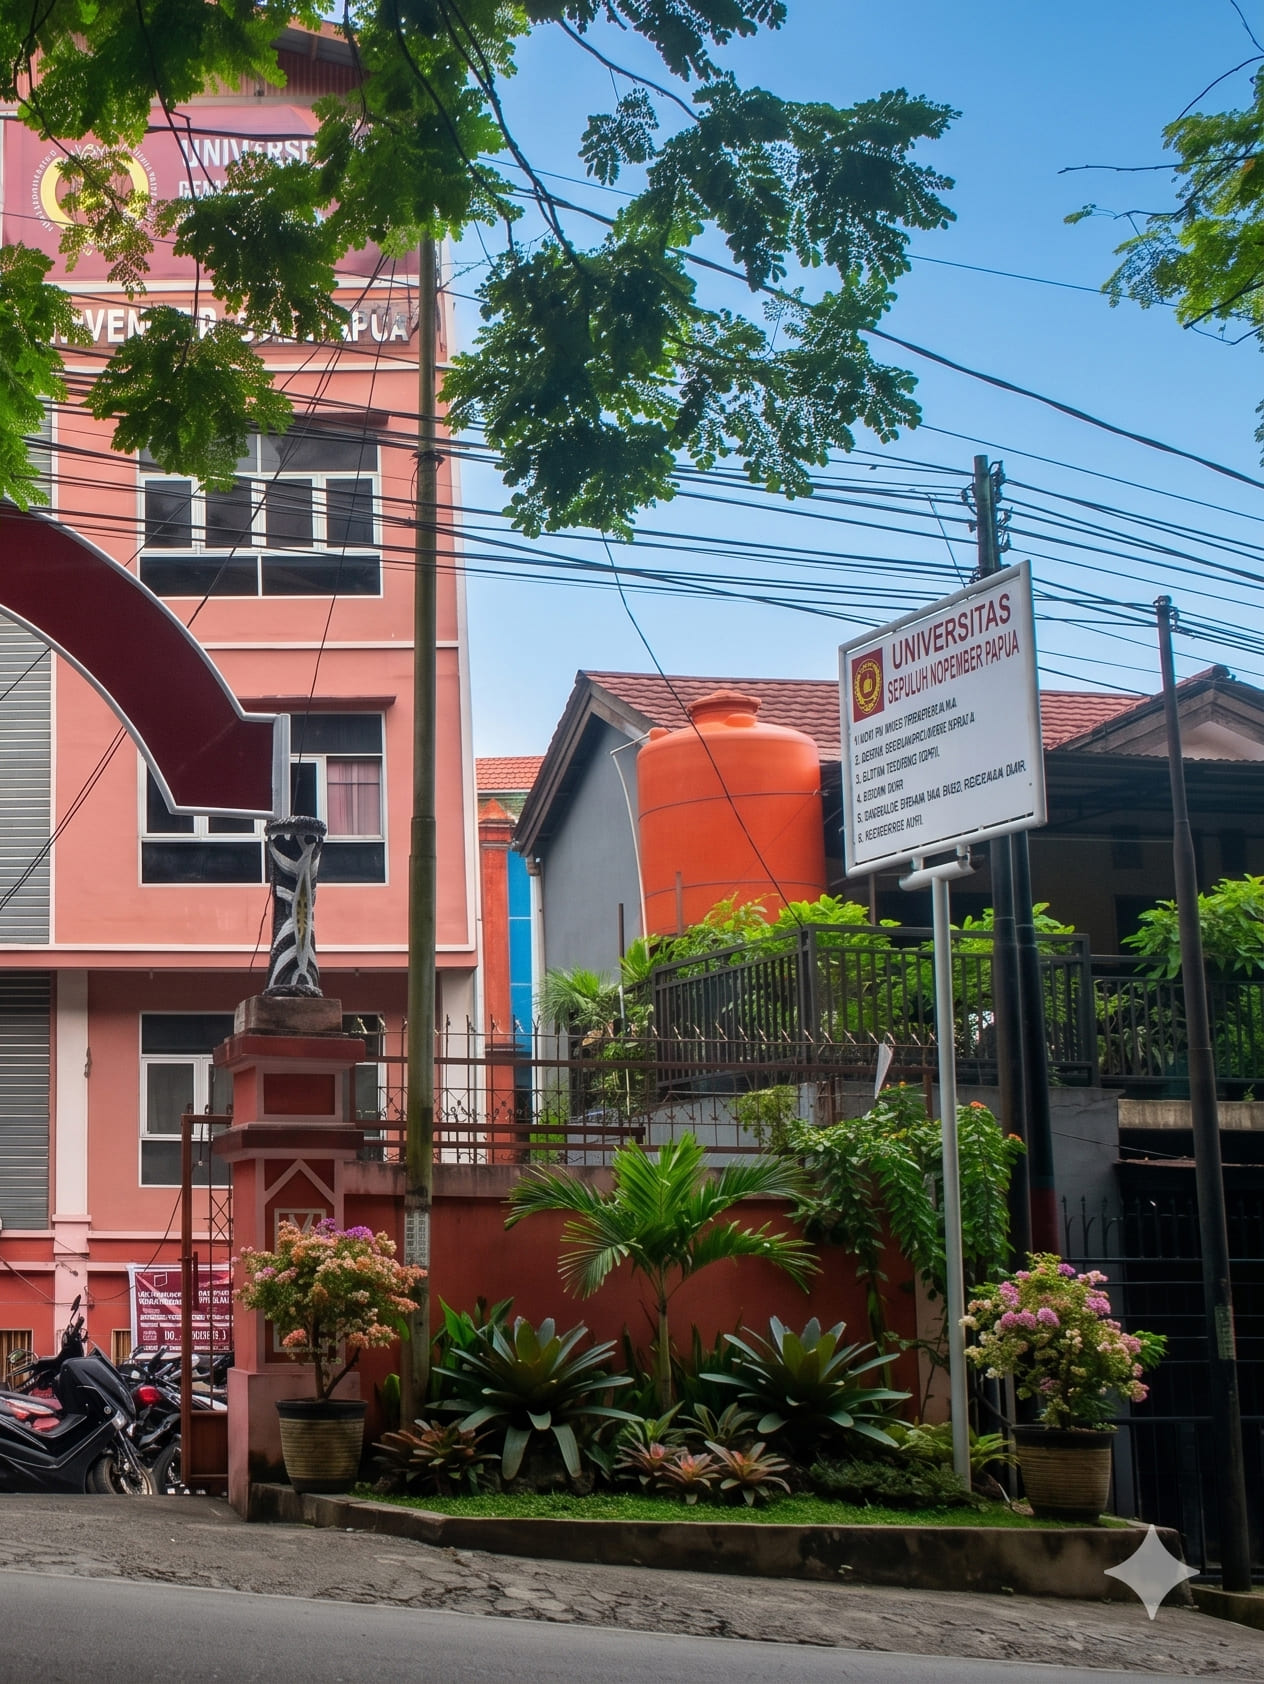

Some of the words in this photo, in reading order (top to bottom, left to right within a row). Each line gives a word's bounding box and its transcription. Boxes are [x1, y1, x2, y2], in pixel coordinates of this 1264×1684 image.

[887, 662, 928, 704] SEPULUH
[930, 644, 983, 687] NOPEMBER
[985, 629, 1020, 665] PAPUA
[892, 593, 1011, 669] UNIVERSITAS
